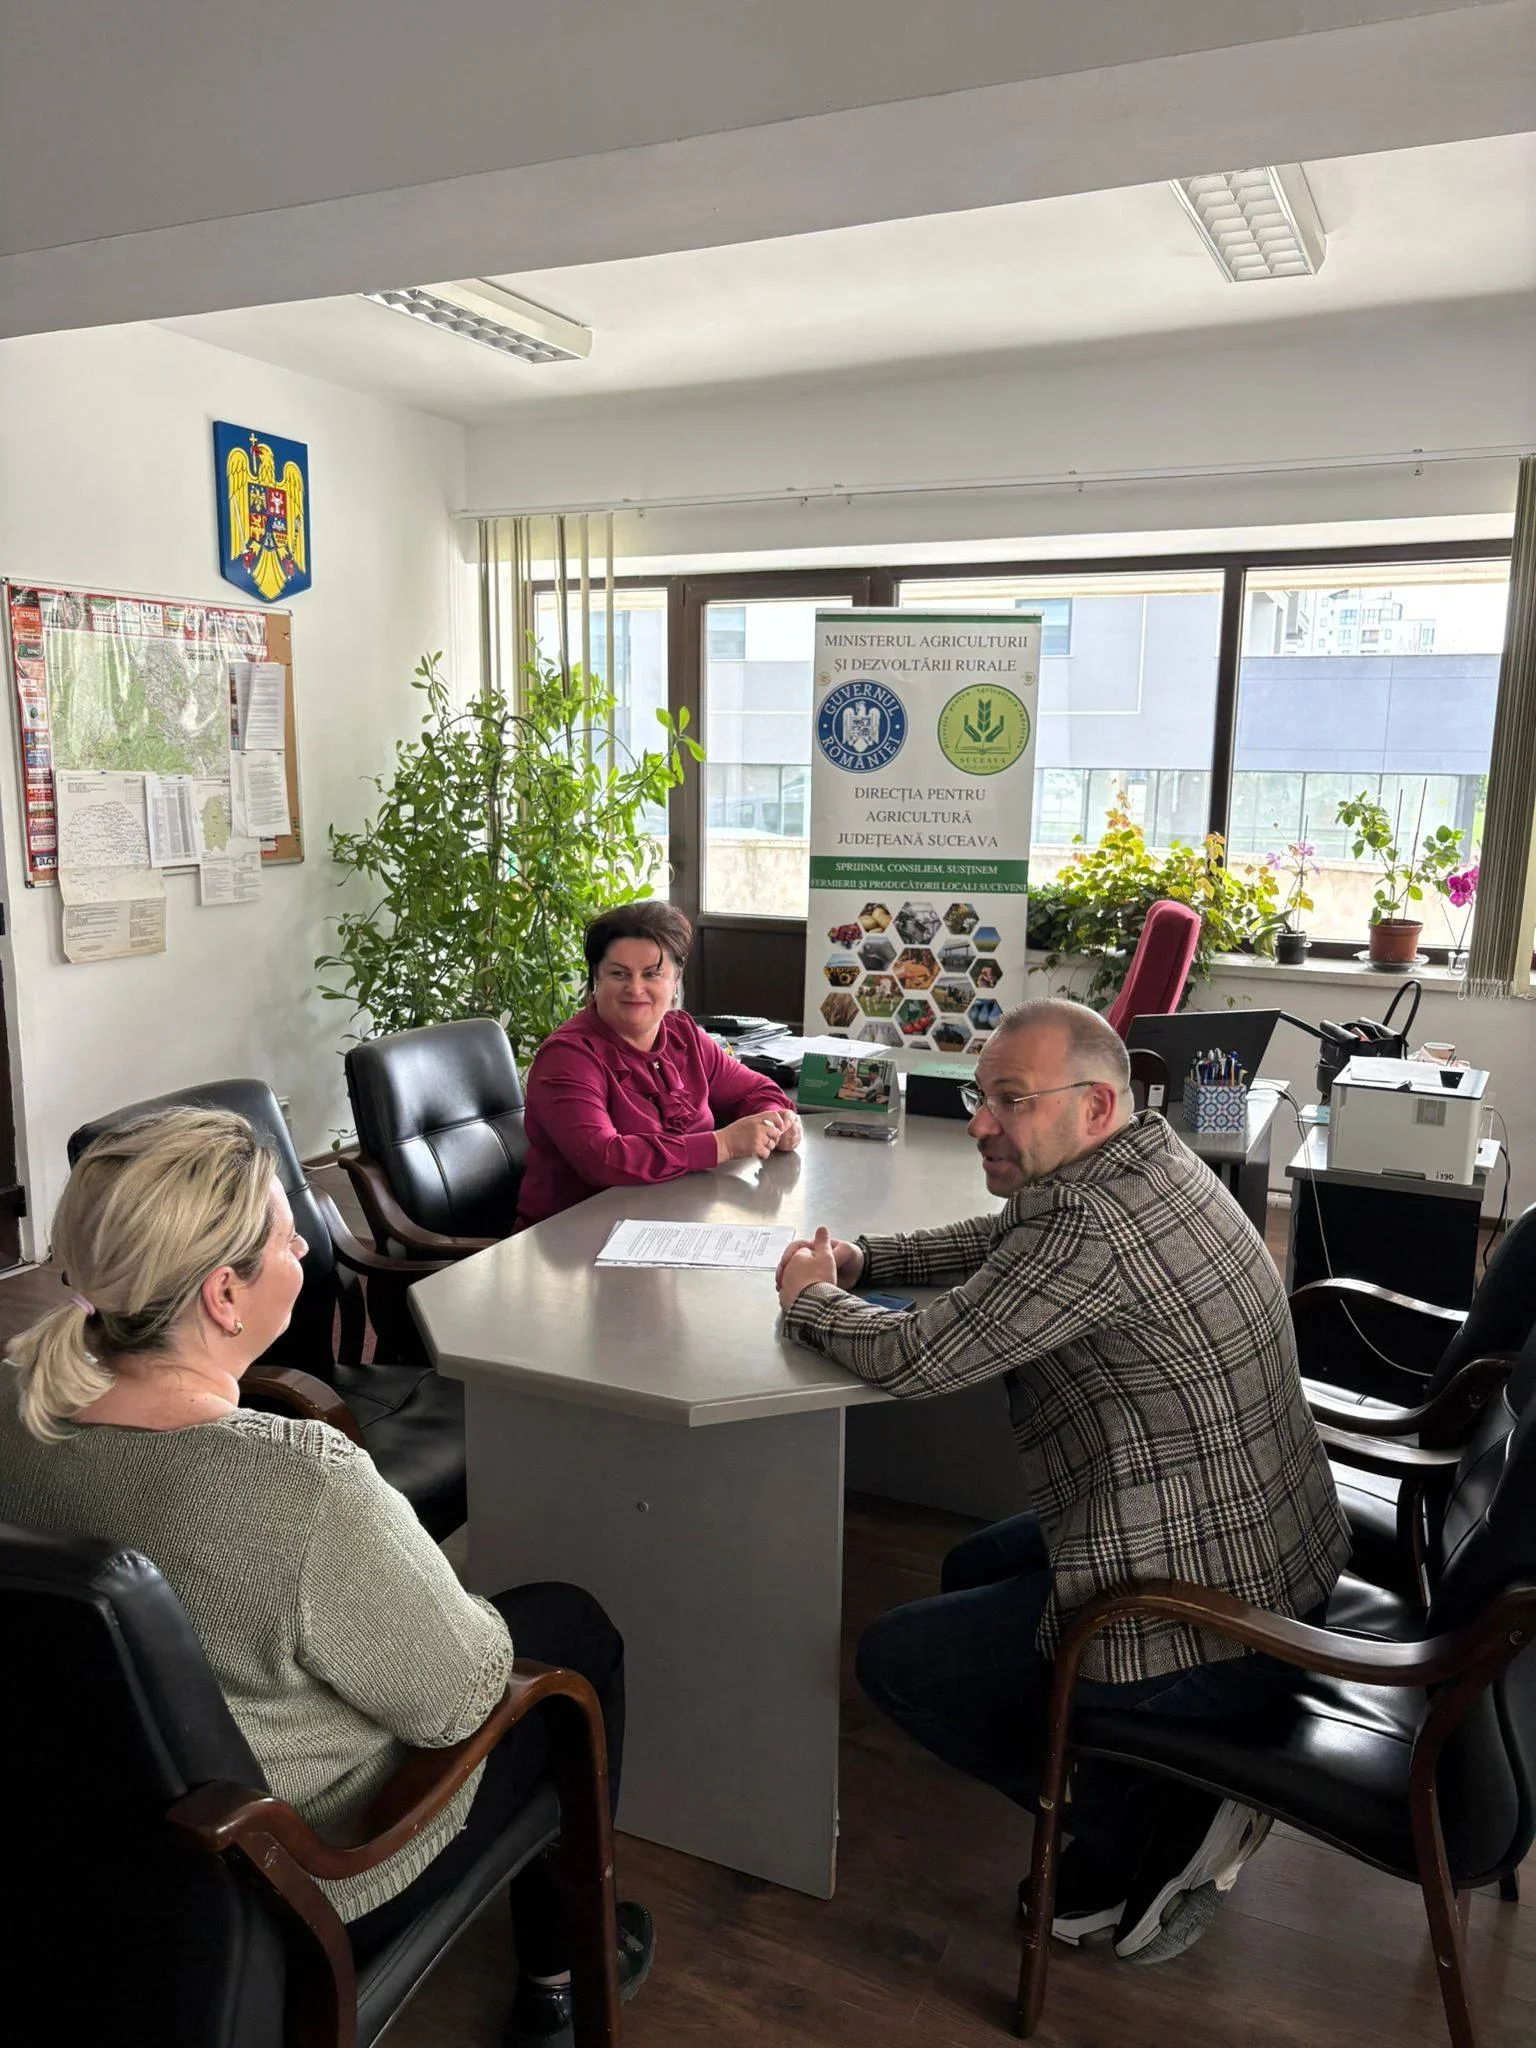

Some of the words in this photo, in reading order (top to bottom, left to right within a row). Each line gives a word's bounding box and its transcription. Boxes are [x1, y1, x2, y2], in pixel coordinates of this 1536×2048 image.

[825, 634, 916, 648] MINISTERUL
[919, 635, 1028, 649] AGRICULTURII
[834, 658, 848, 673] ȘI
[851, 657, 951, 672] DEZVOLTĂRII
[955, 658, 1017, 672] RURALE
[824, 683, 900, 717] GUVERNUL
[855, 787, 923, 802] DIRECȚIA
[927, 788, 986, 801] PENTRU
[865, 809, 972, 824] AGRICULTURĂ
[837, 832, 923, 847] JUDEȚEANĂ
[927, 834, 998, 847] SUCEAVA
[887, 864, 944, 874] CONSILIEM,
[811, 879, 857, 888] FERMIERII
[869, 879, 939, 890] PRODUCĂTORII
[941, 882, 977, 891] LOCALI
